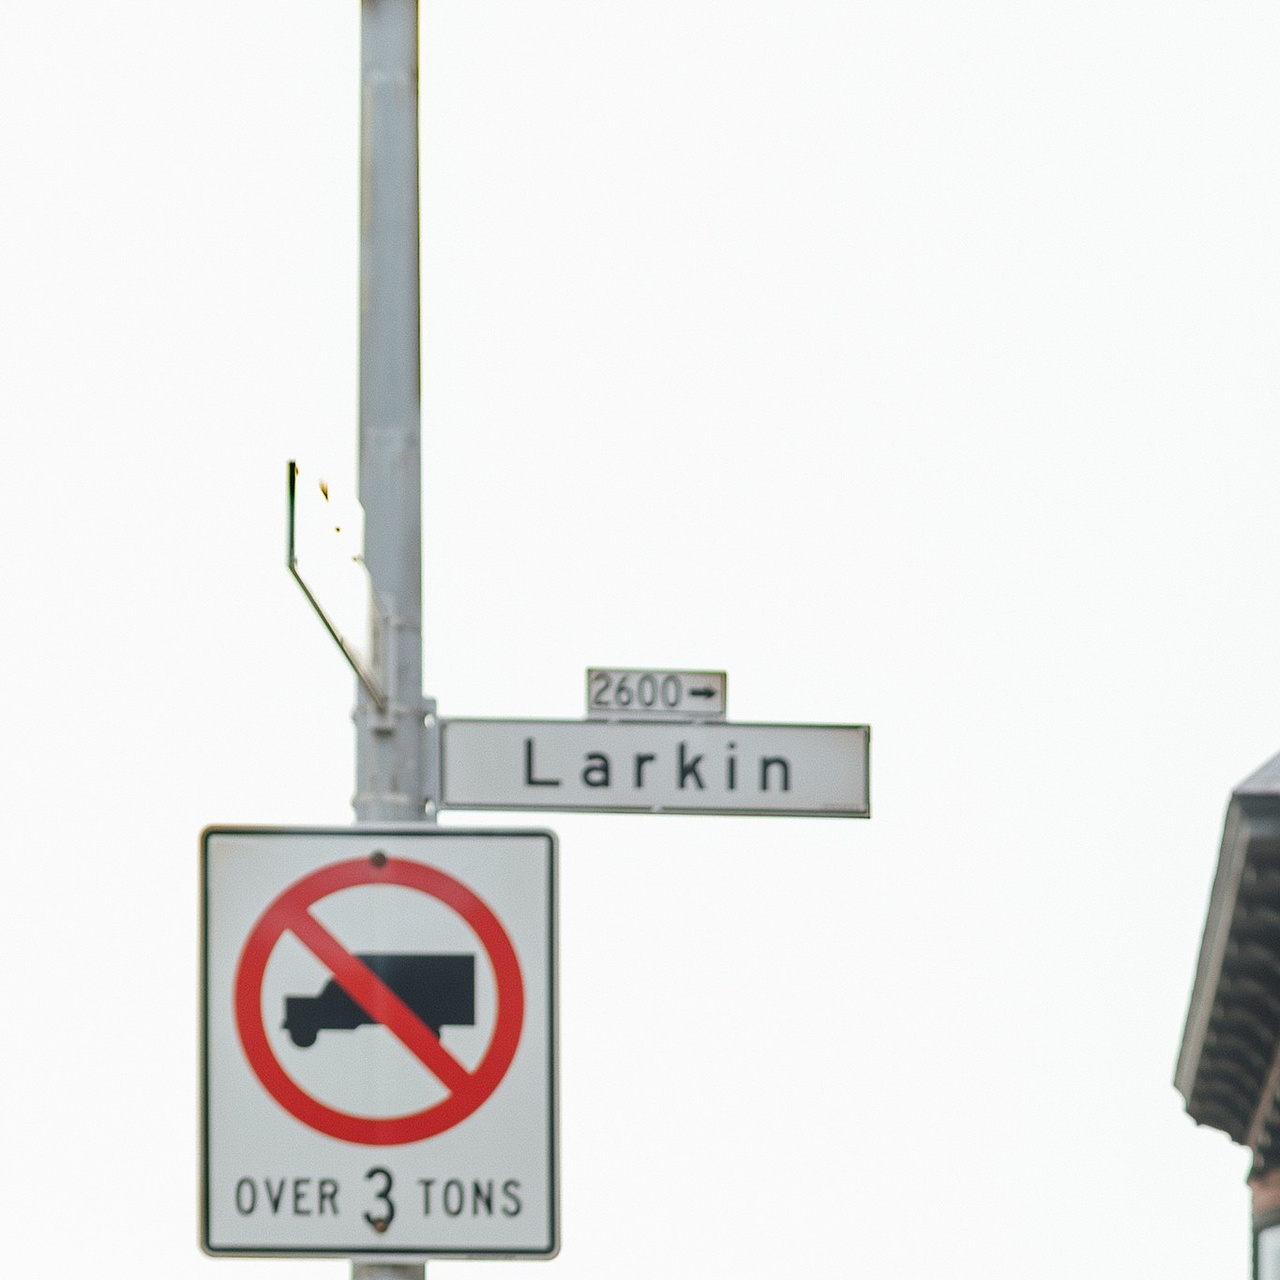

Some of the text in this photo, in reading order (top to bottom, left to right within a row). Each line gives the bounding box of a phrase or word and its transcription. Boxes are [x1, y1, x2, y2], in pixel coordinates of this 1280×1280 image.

[593, 673, 682, 708] 2600
[524, 736, 791, 792] Larkin
[235, 1166, 522, 1232] OVER 3 TONS
